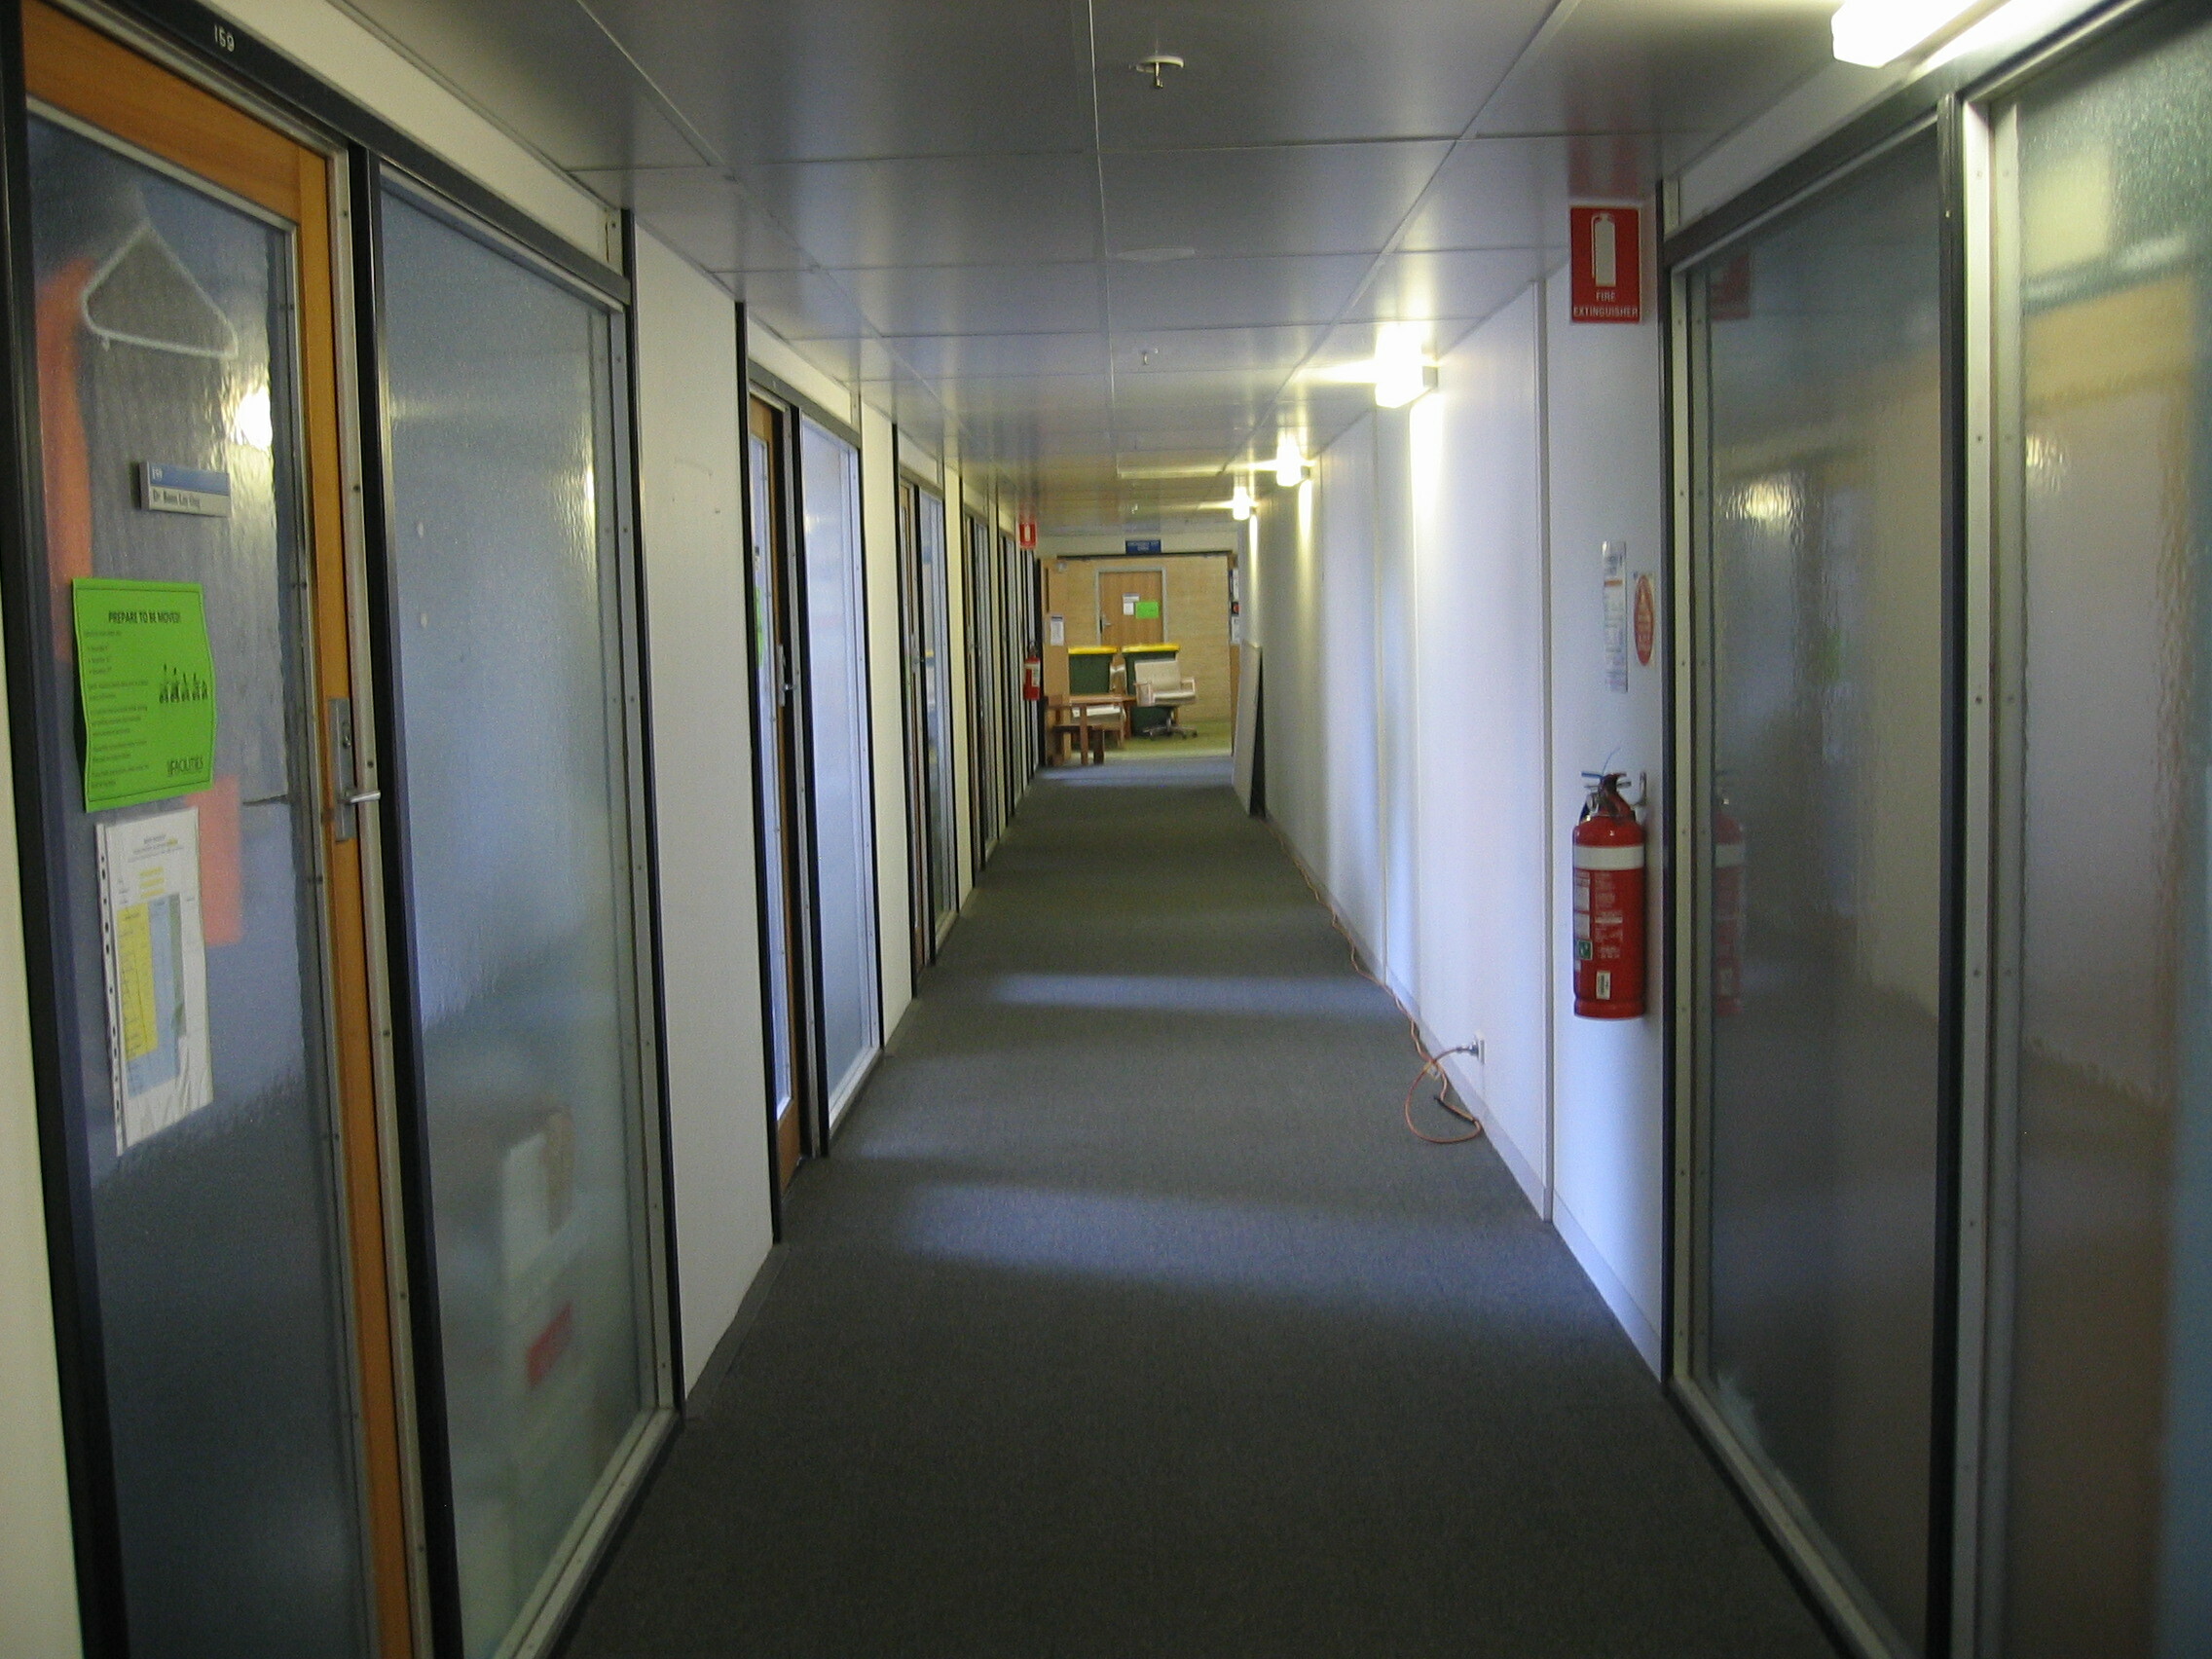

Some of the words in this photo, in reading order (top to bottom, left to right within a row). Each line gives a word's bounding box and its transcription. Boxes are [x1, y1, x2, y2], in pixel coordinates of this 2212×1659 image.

[1596, 290, 1616, 302] FIRE
[1573, 306, 1639, 318] EXTINGUISHER
[108, 610, 137, 624] PREPARE
[139, 611, 148, 624] TO
